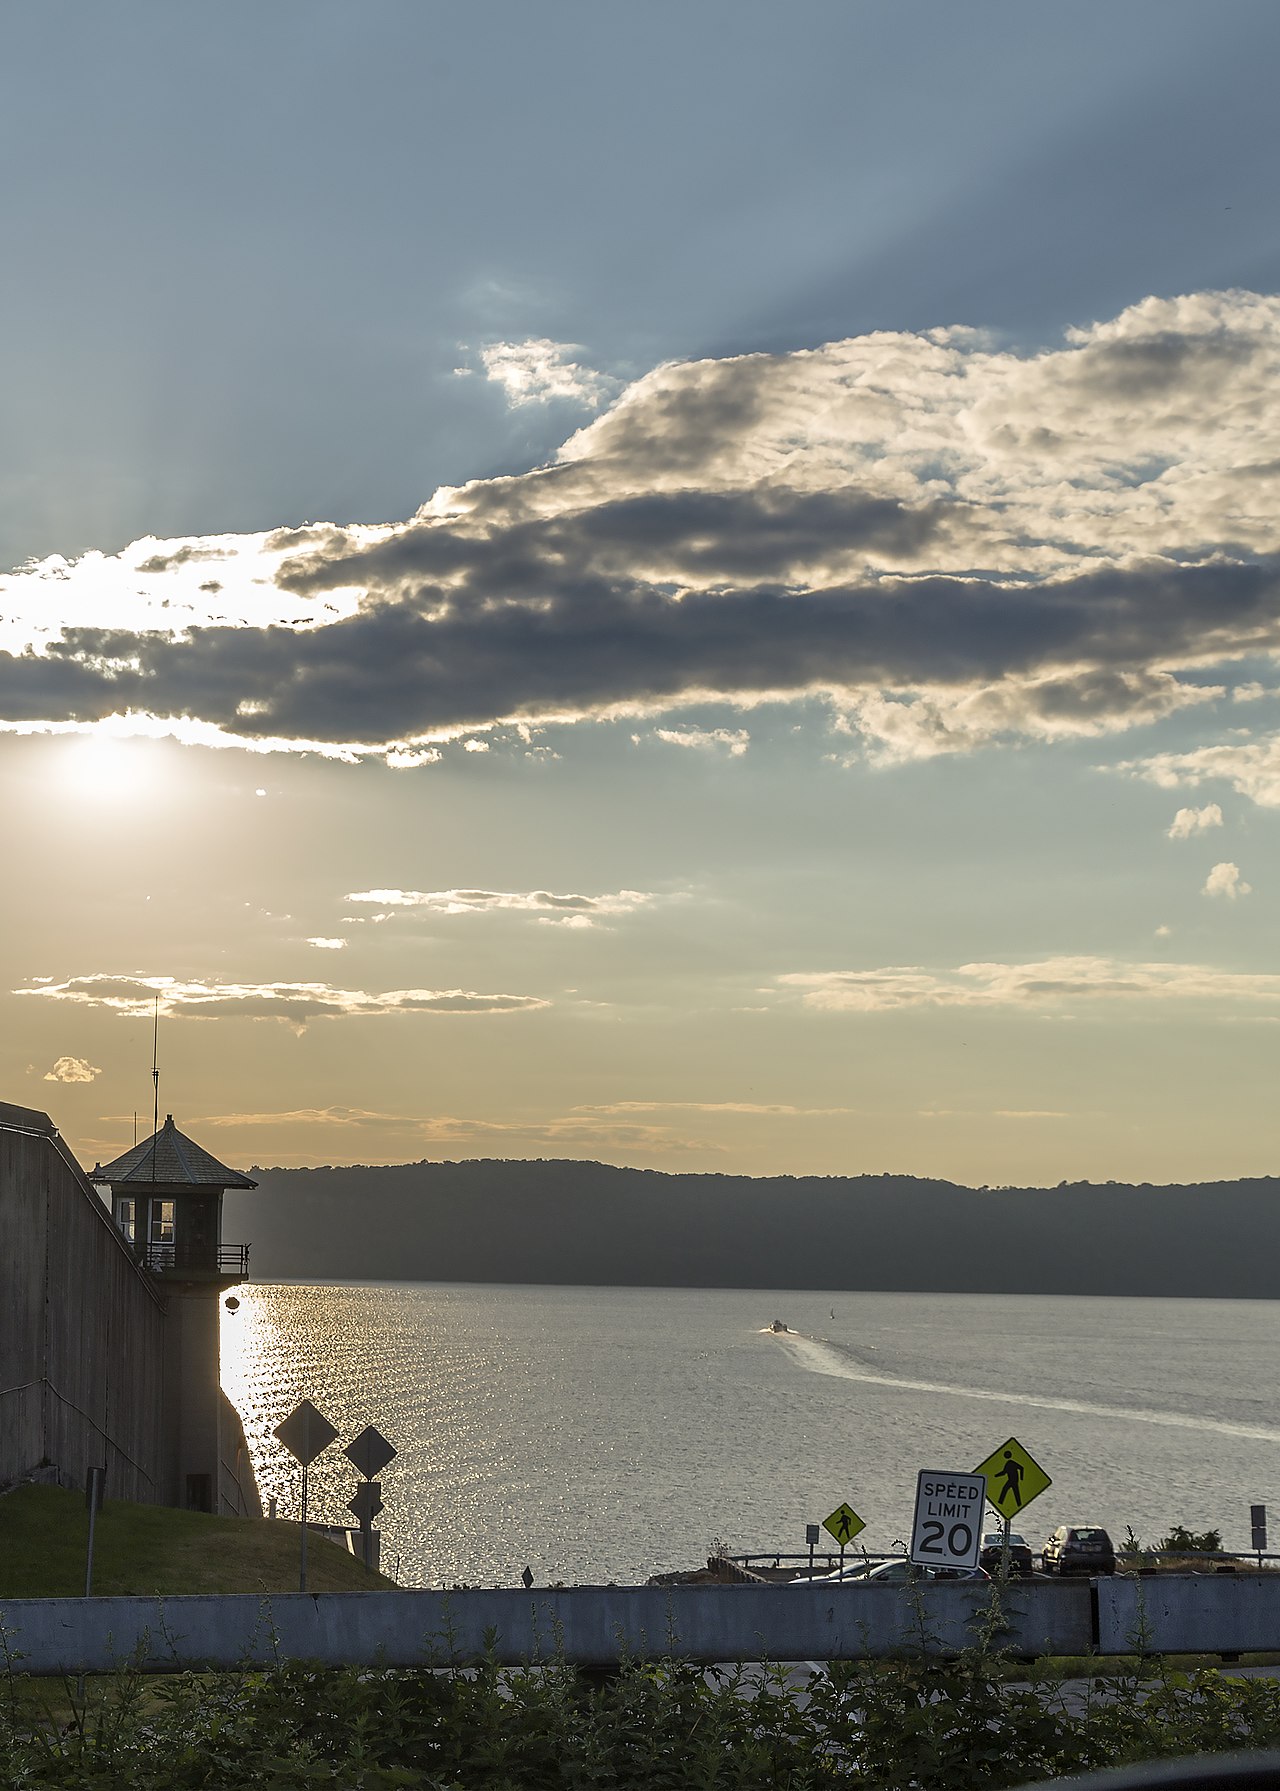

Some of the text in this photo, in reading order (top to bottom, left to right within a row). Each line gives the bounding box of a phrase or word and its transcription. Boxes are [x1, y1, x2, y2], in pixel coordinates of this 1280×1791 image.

[924, 1483, 979, 1500] SPEED
[928, 1502, 971, 1518] LIMIT
[919, 1521, 972, 1556] 20
